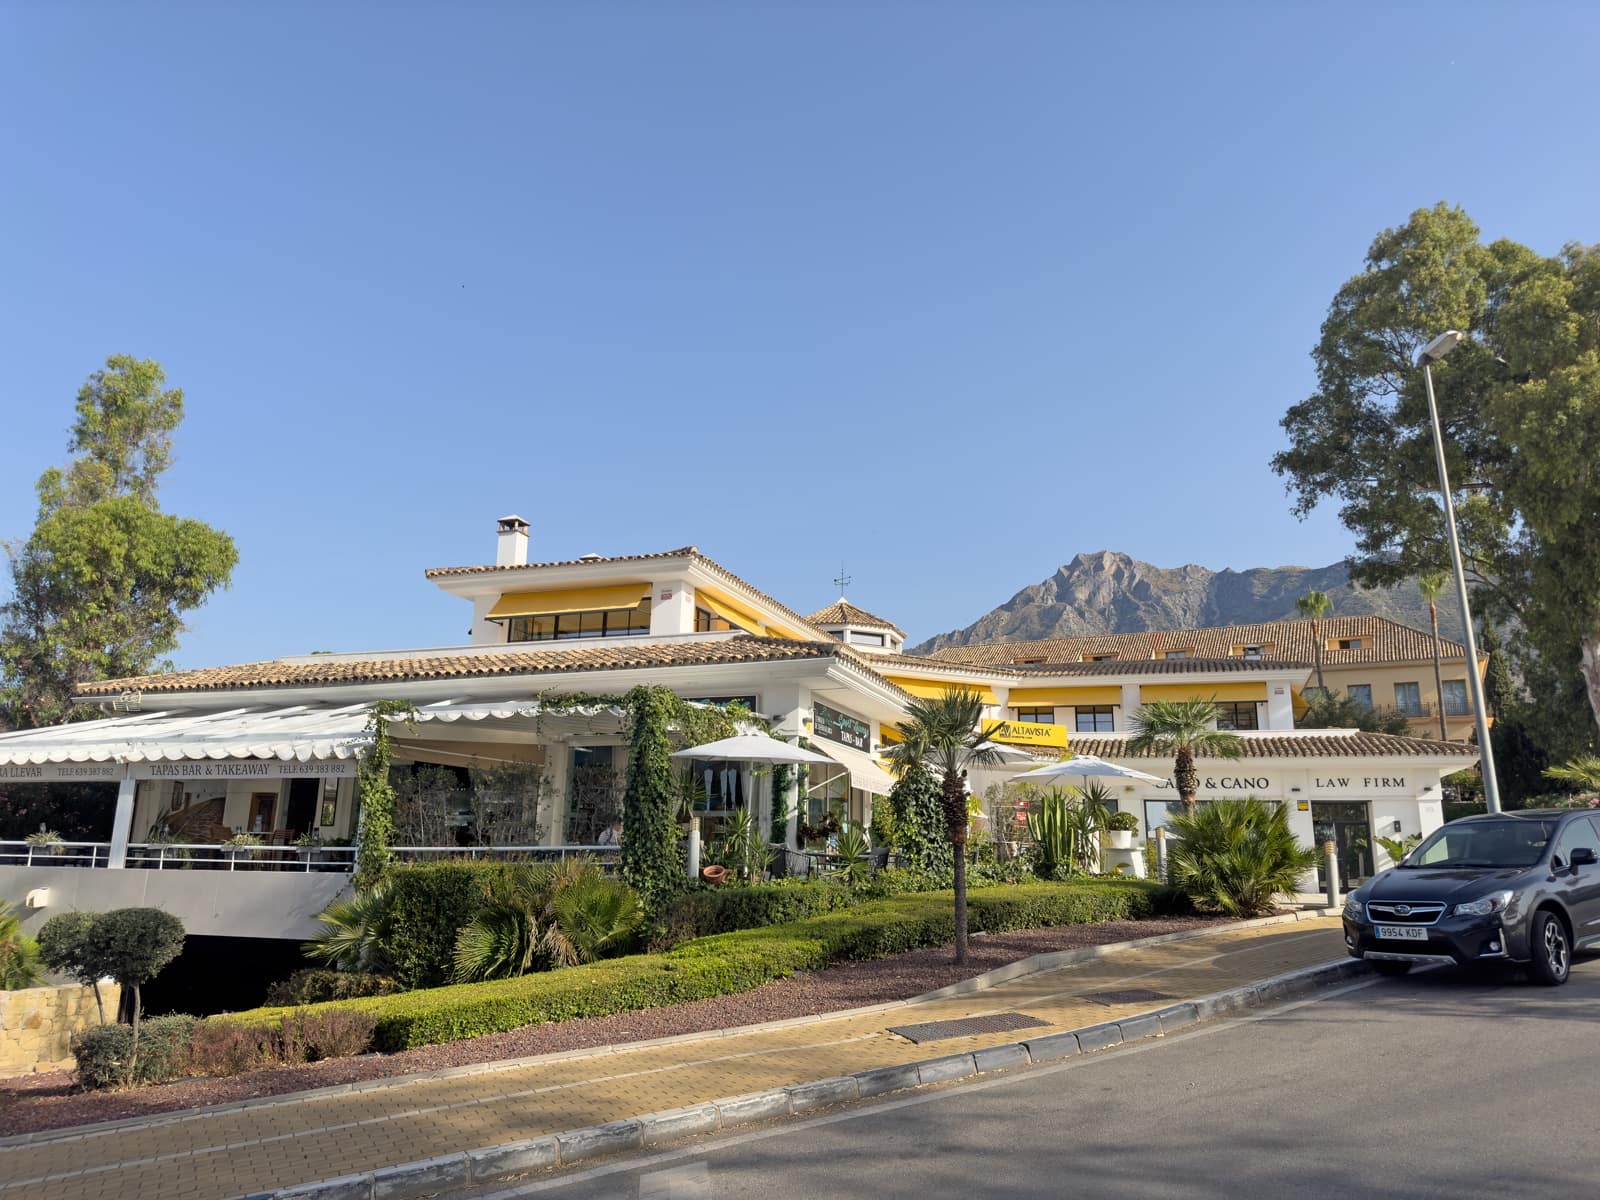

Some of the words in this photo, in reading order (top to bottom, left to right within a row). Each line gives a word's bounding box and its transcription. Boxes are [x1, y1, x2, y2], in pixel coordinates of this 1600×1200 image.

[1012, 726, 1051, 737] ALTAVISTA
[10, 767, 42, 778] LLEVAR
[149, 764, 179, 776] TAPAS
[182, 764, 202, 776] BAR
[205, 765, 213, 775] &
[215, 763, 270, 775] TAKEAWAY
[299, 764, 314, 774] 639
[1205, 777, 1217, 789] &
[1220, 777, 1269, 789] CANO
[1315, 777, 1350, 788] LAW
[1363, 777, 1405, 788] FIRM
[1381, 927, 1404, 937] 9954
